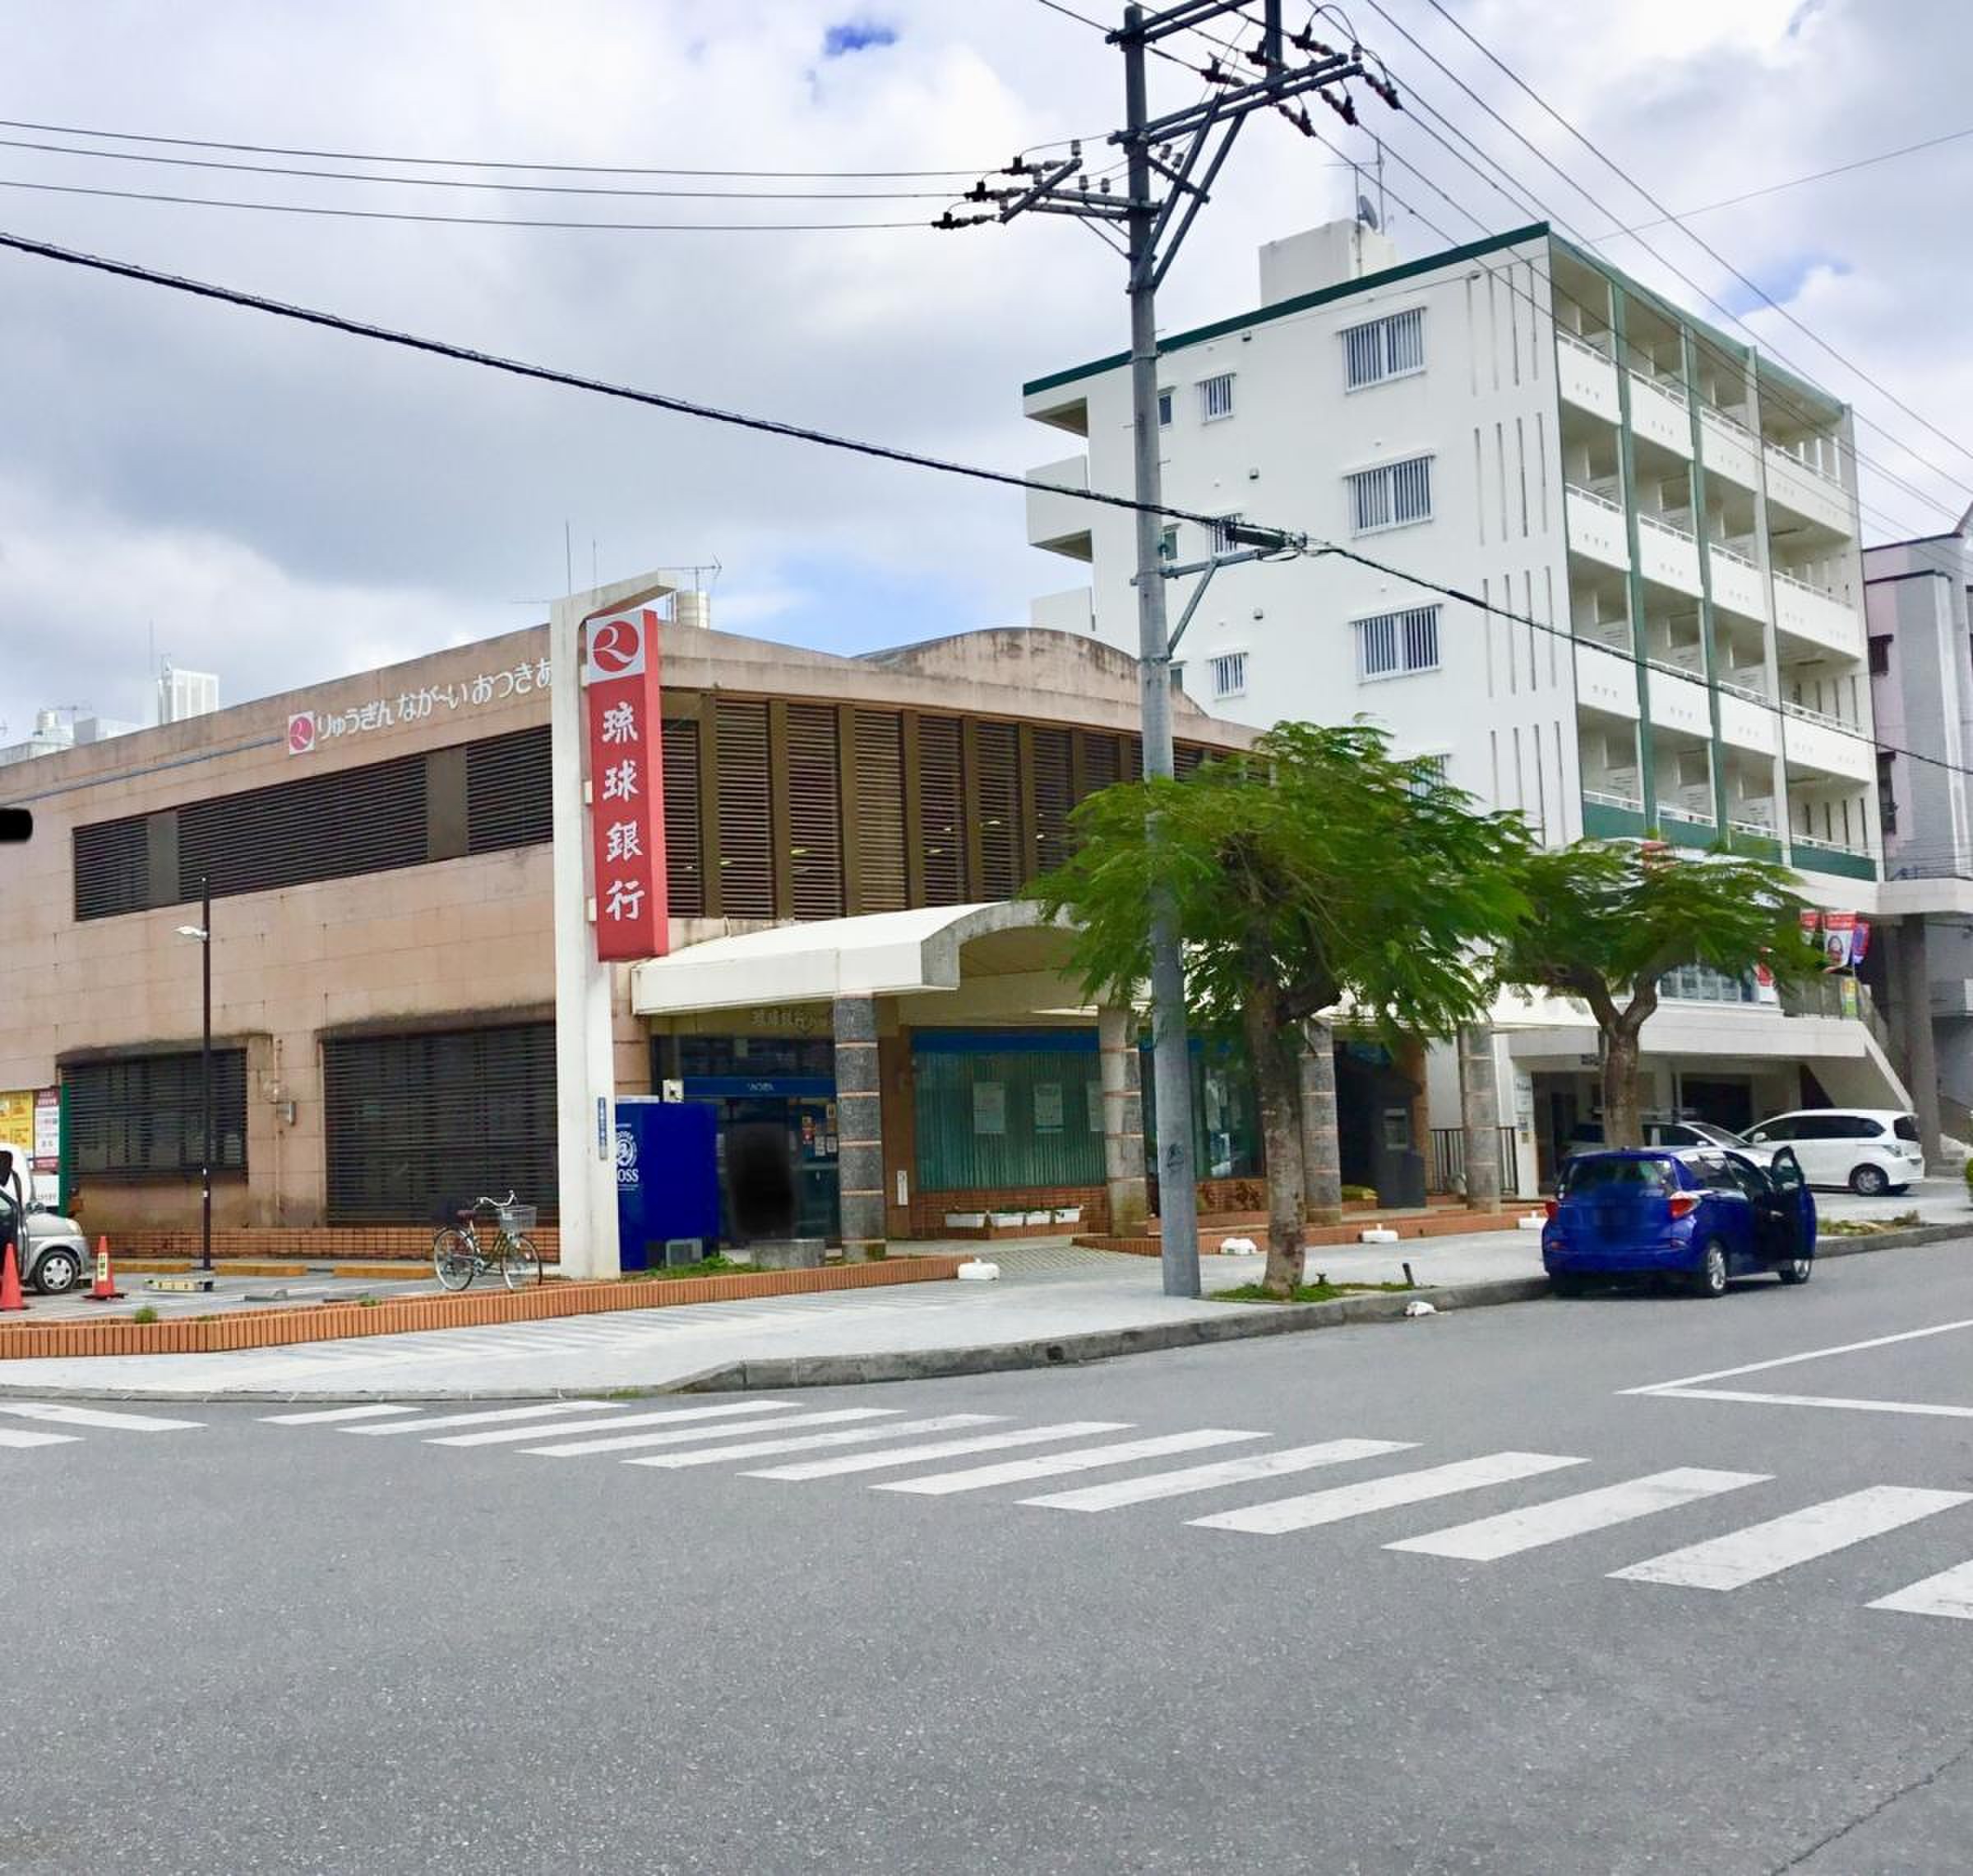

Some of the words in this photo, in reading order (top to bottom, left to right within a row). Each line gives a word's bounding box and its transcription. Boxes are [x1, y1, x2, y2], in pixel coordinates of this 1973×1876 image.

[317, 700, 395, 739] りゅうぎん
[602, 701, 645, 921] 琉球銀行
